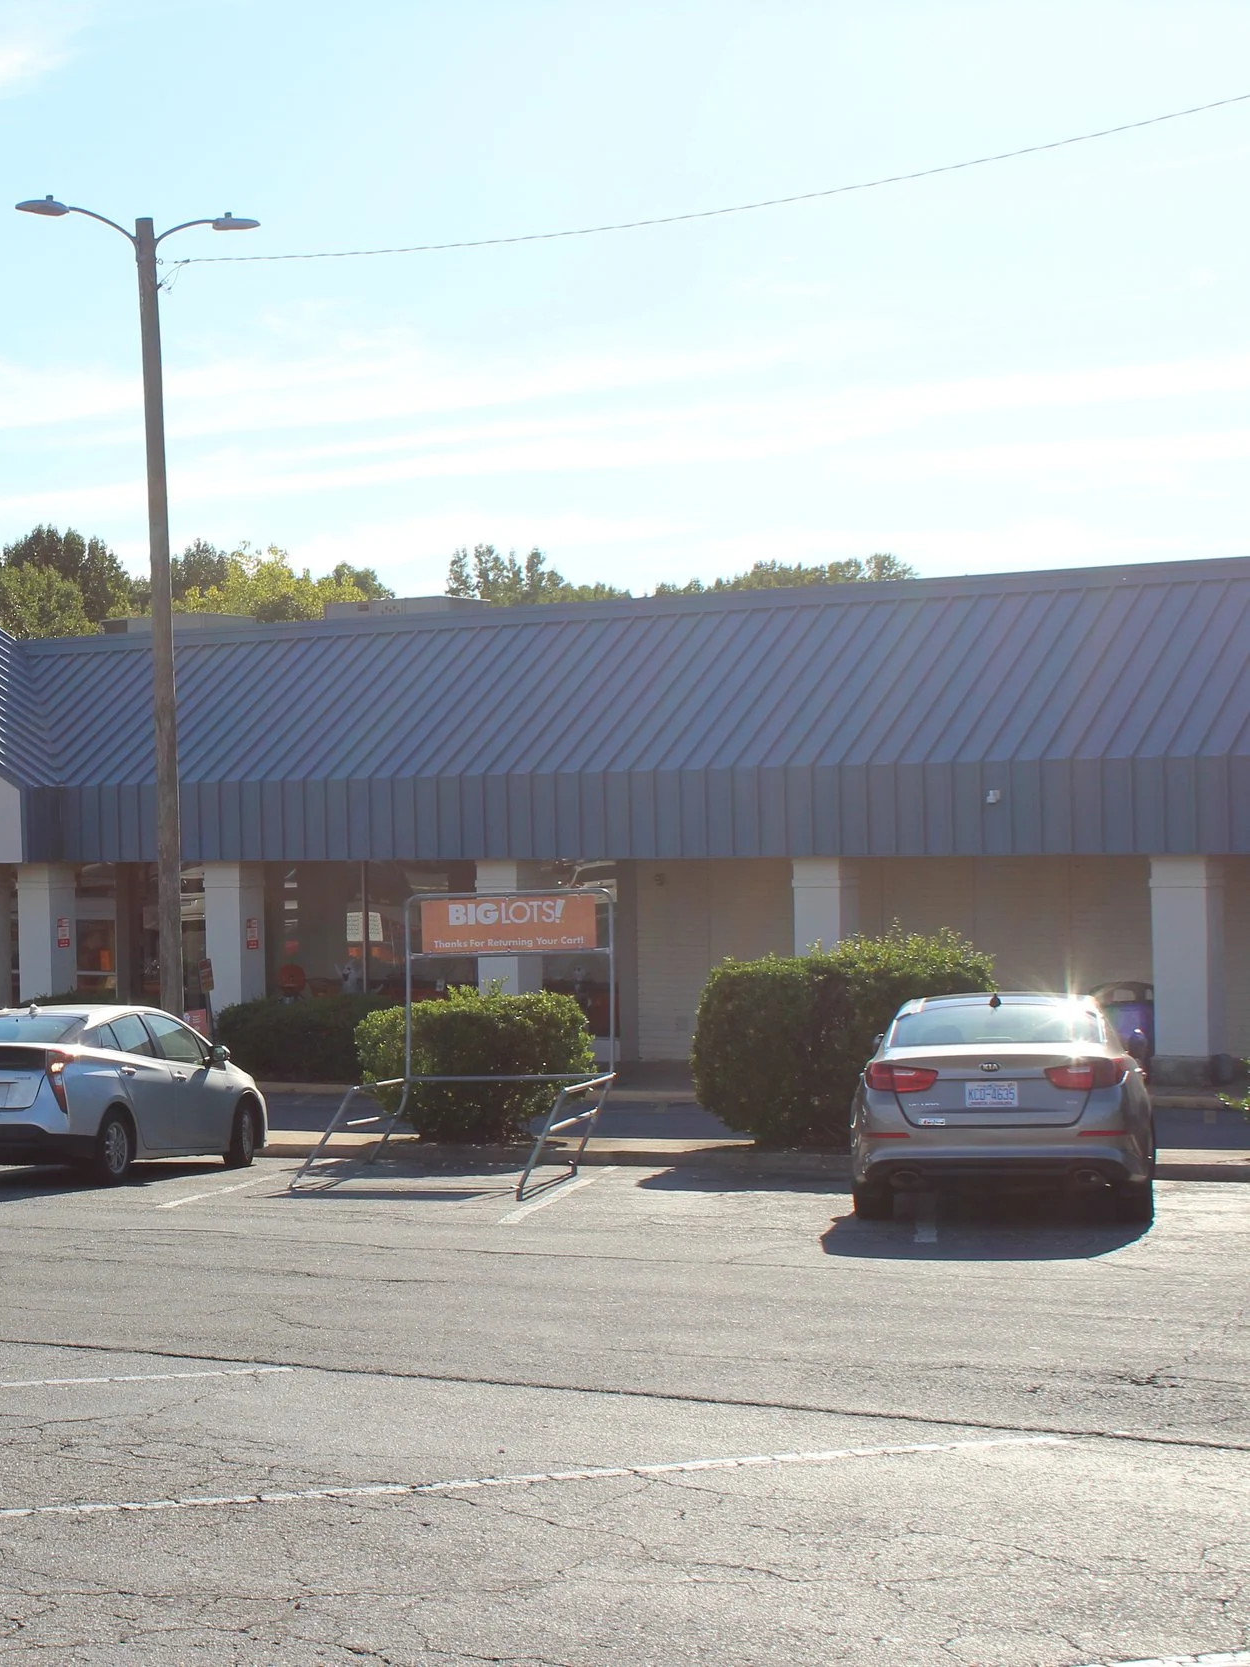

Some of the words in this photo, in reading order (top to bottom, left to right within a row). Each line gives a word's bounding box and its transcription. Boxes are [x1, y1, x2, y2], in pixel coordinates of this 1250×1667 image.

[433, 938, 468, 949] Thanks
[469, 937, 485, 948] For
[487, 937, 534, 948] Returning
[536, 936, 558, 946] Your
[560, 935, 584, 945] Cart!
